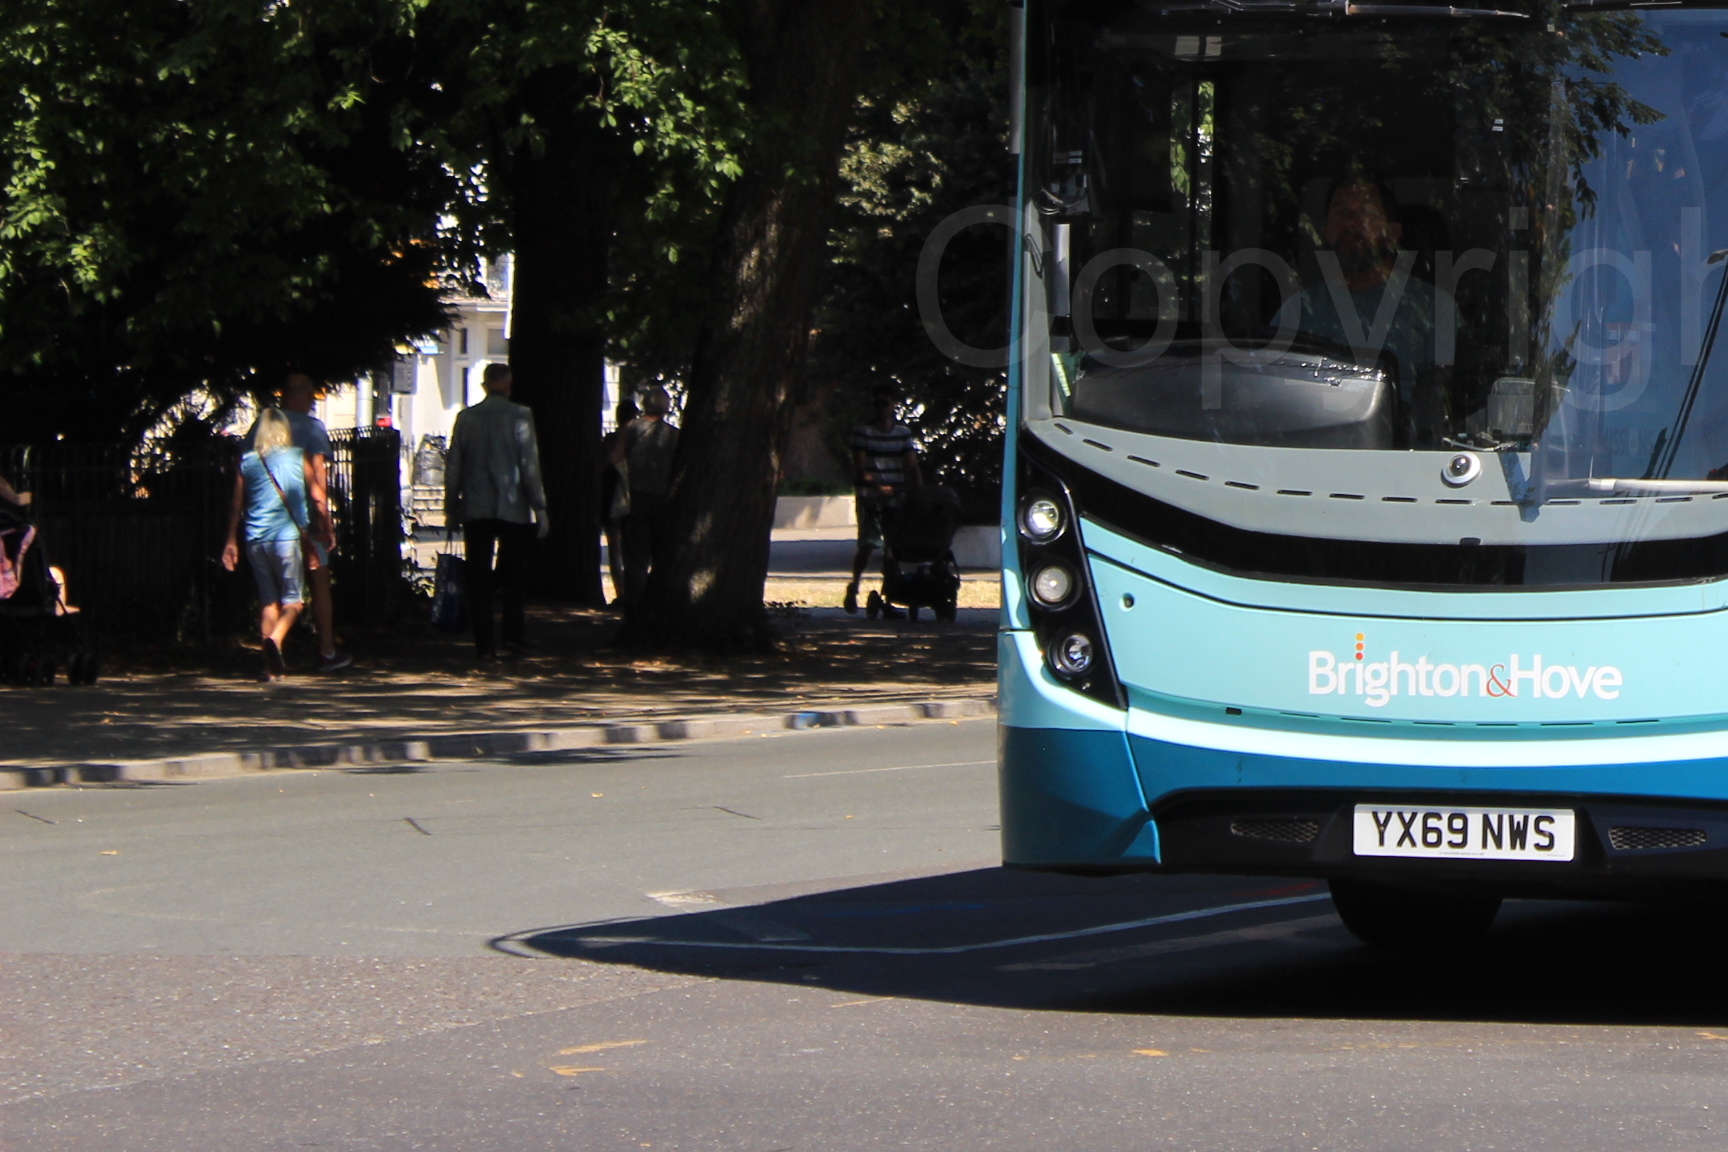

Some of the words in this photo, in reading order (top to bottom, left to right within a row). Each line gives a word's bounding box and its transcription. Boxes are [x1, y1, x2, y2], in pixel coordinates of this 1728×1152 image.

[1308, 632, 1622, 708] Brighton&Hove
[1372, 811, 1468, 848] YX69
[1481, 813, 1556, 851] NWS
